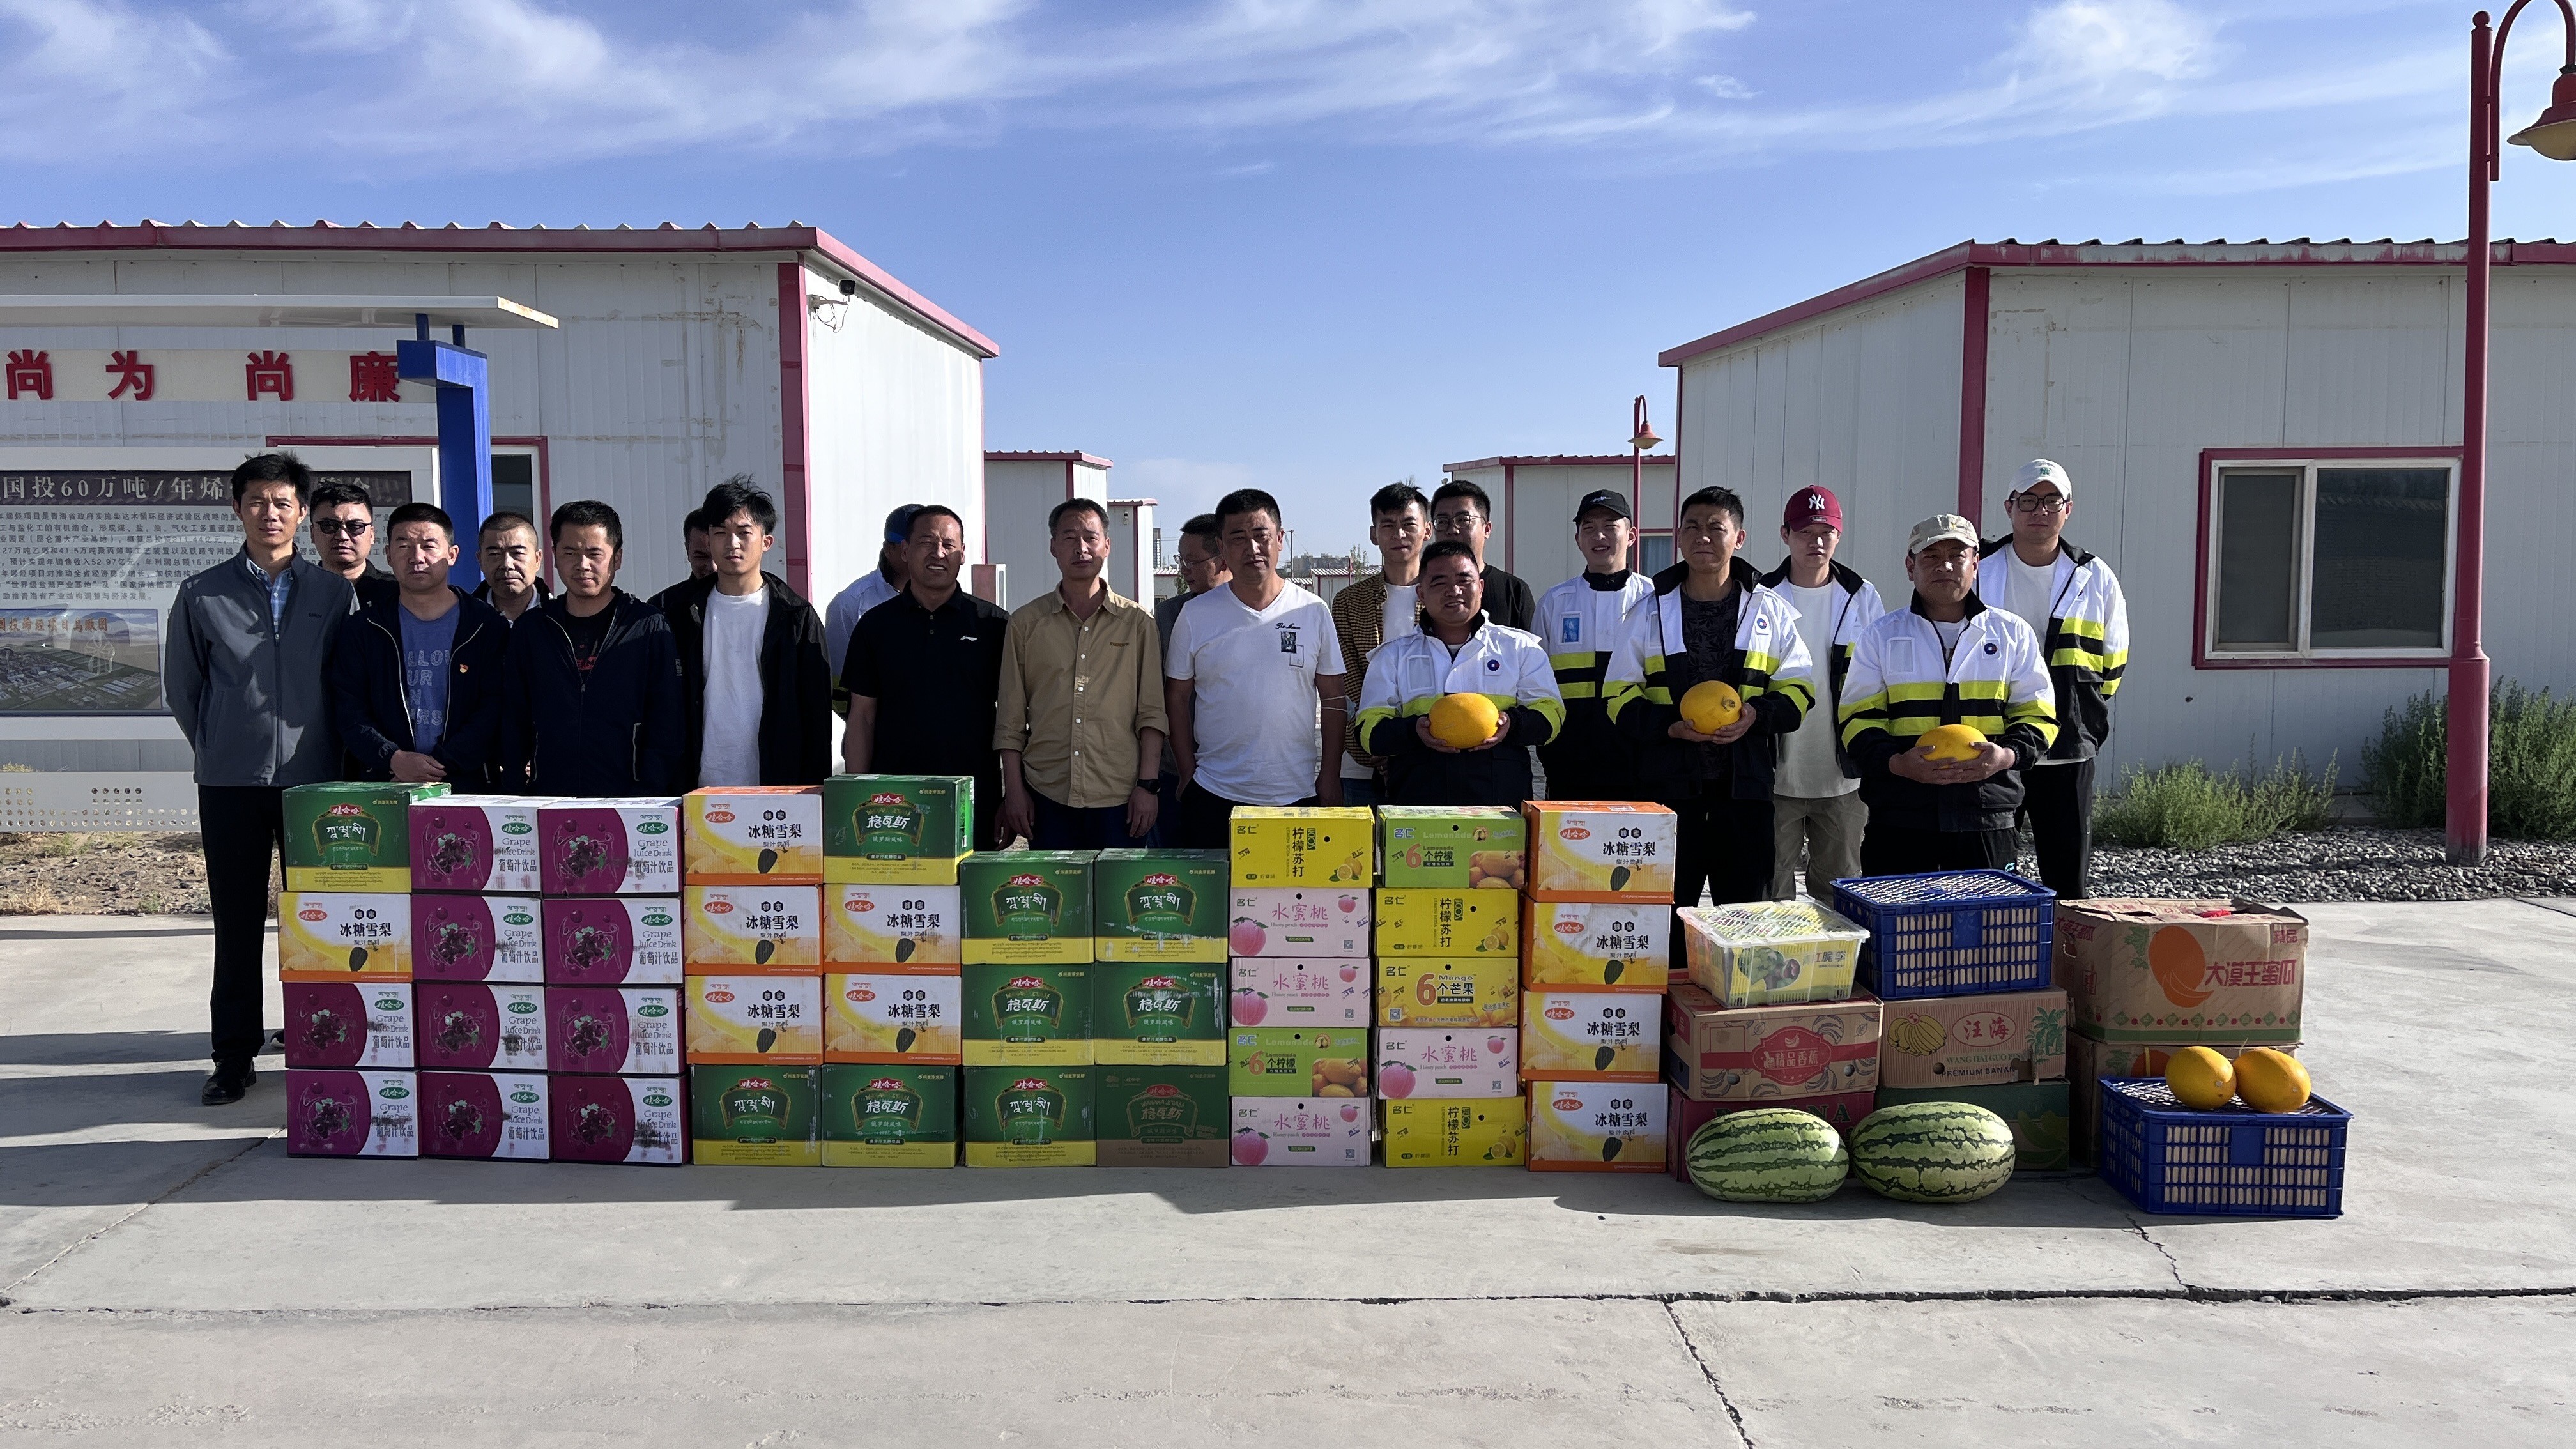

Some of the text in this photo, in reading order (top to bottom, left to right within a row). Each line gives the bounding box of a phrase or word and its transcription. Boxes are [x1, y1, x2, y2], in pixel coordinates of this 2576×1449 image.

[3, 476, 233, 500] 国投60万吨/年烯
[866, 815, 910, 829] 格瓦斯
[748, 824, 802, 839] 冰糖雪梨
[1237, 826, 1257, 834] 名仁
[1395, 829, 1414, 838] 名仁
[502, 838, 531, 847] Grape
[638, 839, 668, 849] Grape
[1603, 841, 1656, 856] 冰糖雪梨
[1292, 827, 1304, 877] 柠檬苏打
[1237, 898, 1256, 907] 名仁
[1384, 896, 1404, 905] 名仁
[1271, 903, 1328, 921] 水蜜桃
[746, 915, 799, 930] 冰糖雪梨
[887, 914, 940, 928] 冰糖雪梨
[1440, 898, 1452, 947] 柠檬苏打
[340, 923, 392, 937] 冰糖雪梨
[504, 929, 532, 939] Grape
[642, 930, 672, 940] Grape
[1597, 935, 1649, 949] 冰糖雪梨
[1238, 969, 1257, 977] 名仁
[1386, 966, 1407, 976] 名仁
[1273, 973, 1329, 990] 水蜜桃
[747, 1004, 800, 1018] 冰糖雪梨
[888, 1004, 940, 1018] 冰糖雪梨
[1006, 998, 1050, 1012] 格瓦斯
[376, 1015, 404, 1024] Grape
[509, 1016, 537, 1026] Grape
[638, 1022, 668, 1031] Grape
[1587, 1022, 1640, 1036] 冰糖雪梨
[1963, 1016, 2009, 1040] 汪海
[1238, 1036, 1257, 1045] 名仁
[1386, 1041, 1405, 1050] 名仁
[1421, 1045, 1477, 1062] 水蜜桃
[1947, 1056, 1972, 1064] WANG
[1973, 1055, 1988, 1063] HAI
[1989, 1054, 2007, 1062] GUO
[1985, 1066, 2016, 1075] BANAN
[380, 1103, 408, 1113] Grape
[511, 1105, 539, 1115] Grape
[866, 1100, 909, 1114] 格瓦斯
[1239, 1109, 1259, 1117] 名仁
[1393, 1106, 1413, 1114] 名仁
[644, 1110, 672, 1120] Grape
[1595, 1113, 1648, 1127] 冰糖雪梨
[1273, 1114, 1330, 1131] 水蜜桃
[1448, 1107, 1459, 1156] 柠檬苏打
